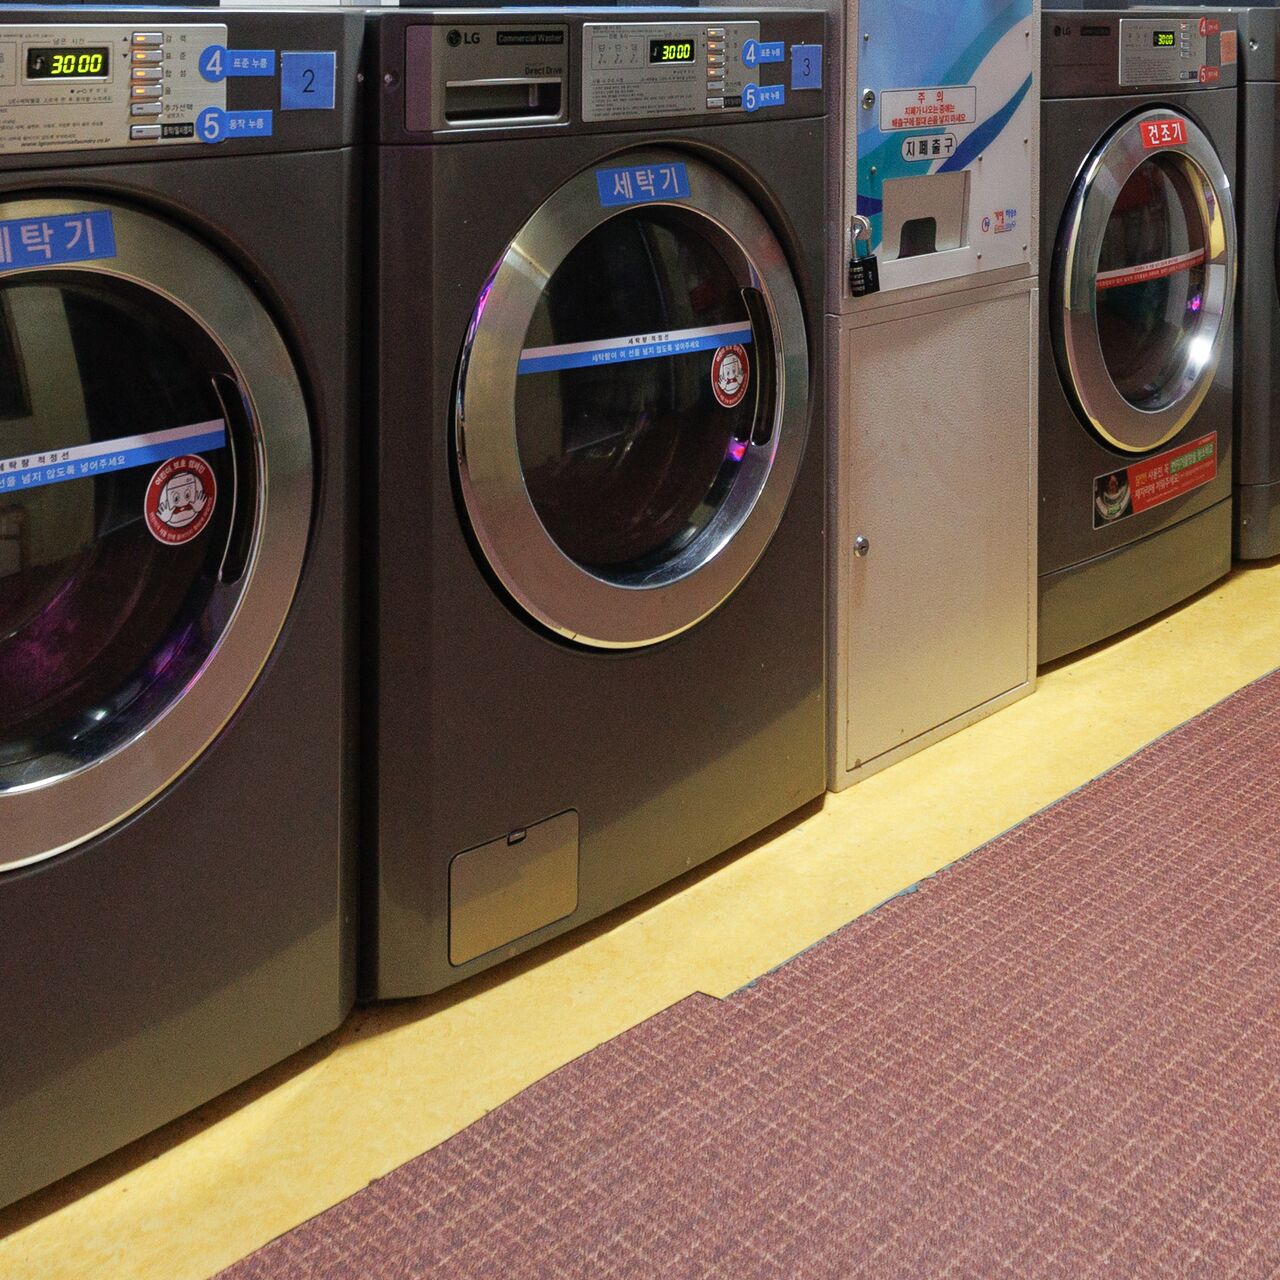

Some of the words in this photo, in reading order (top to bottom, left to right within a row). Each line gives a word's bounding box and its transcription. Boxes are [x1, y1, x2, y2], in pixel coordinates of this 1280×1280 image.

[463, 32, 480, 45] LG
[205, 50, 223, 76] 4
[746, 43, 756, 64] 4
[802, 57, 811, 77] 3
[301, 69, 316, 93] 2
[746, 89, 756, 109] 5
[204, 113, 220, 139] 5
[1148, 122, 1183, 145] 건조기
[612, 167, 680, 199] 세탁기
